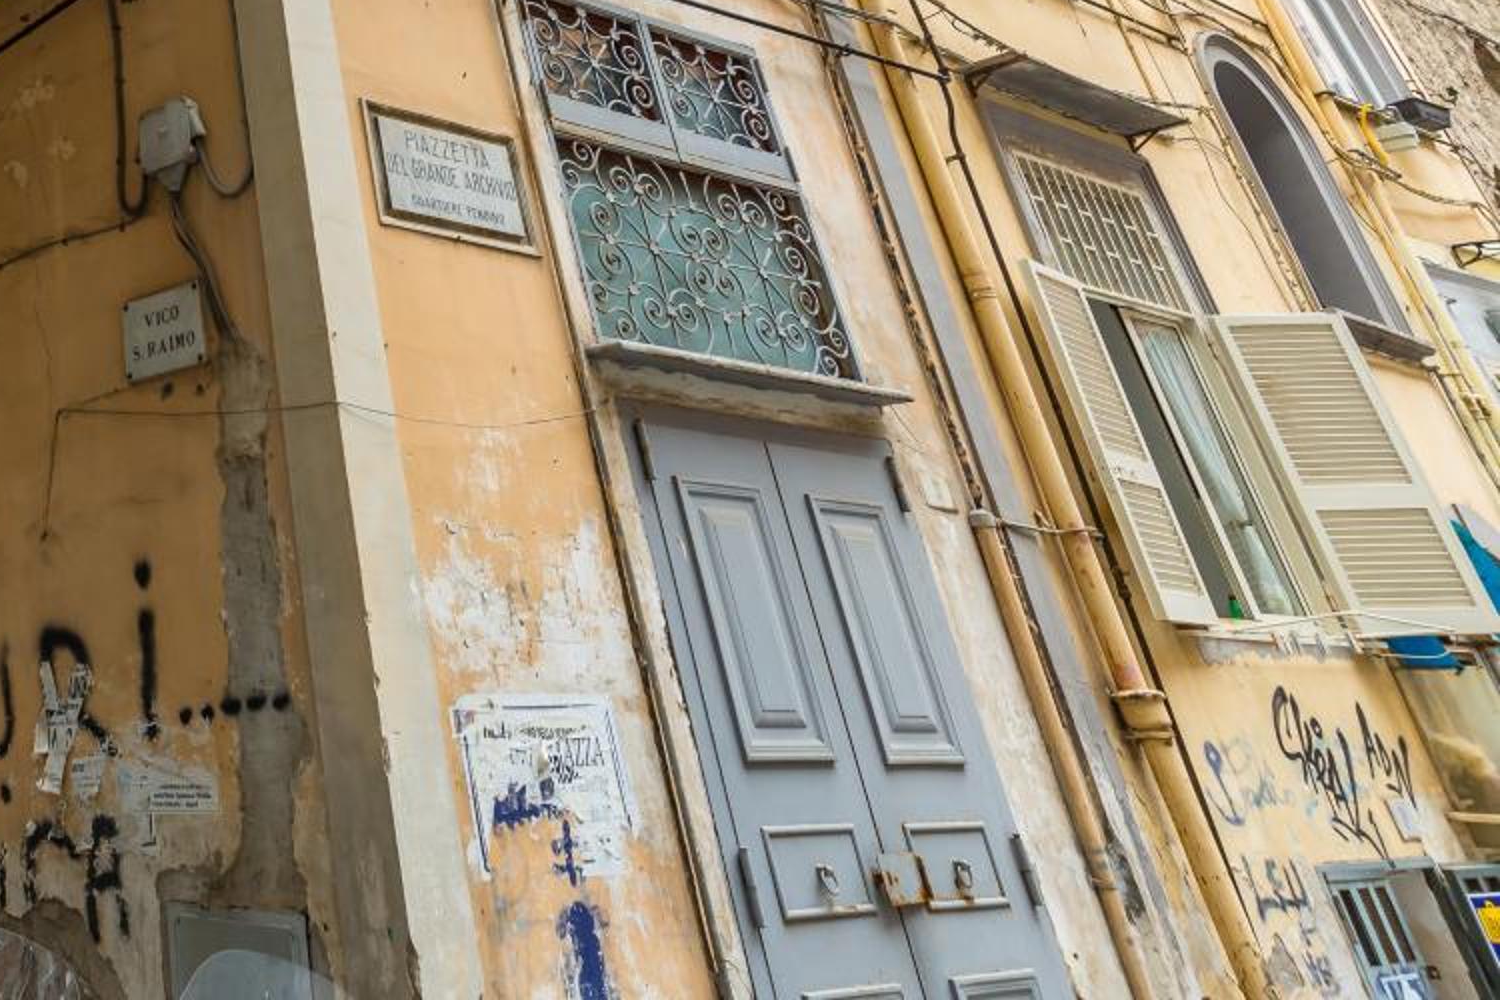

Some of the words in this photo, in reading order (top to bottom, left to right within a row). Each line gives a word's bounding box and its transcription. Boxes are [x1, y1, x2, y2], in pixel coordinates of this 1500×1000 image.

[403, 129, 490, 170] PIAZZETTA
[144, 304, 180, 328] VICO
[146, 331, 196, 359] RAIMO
